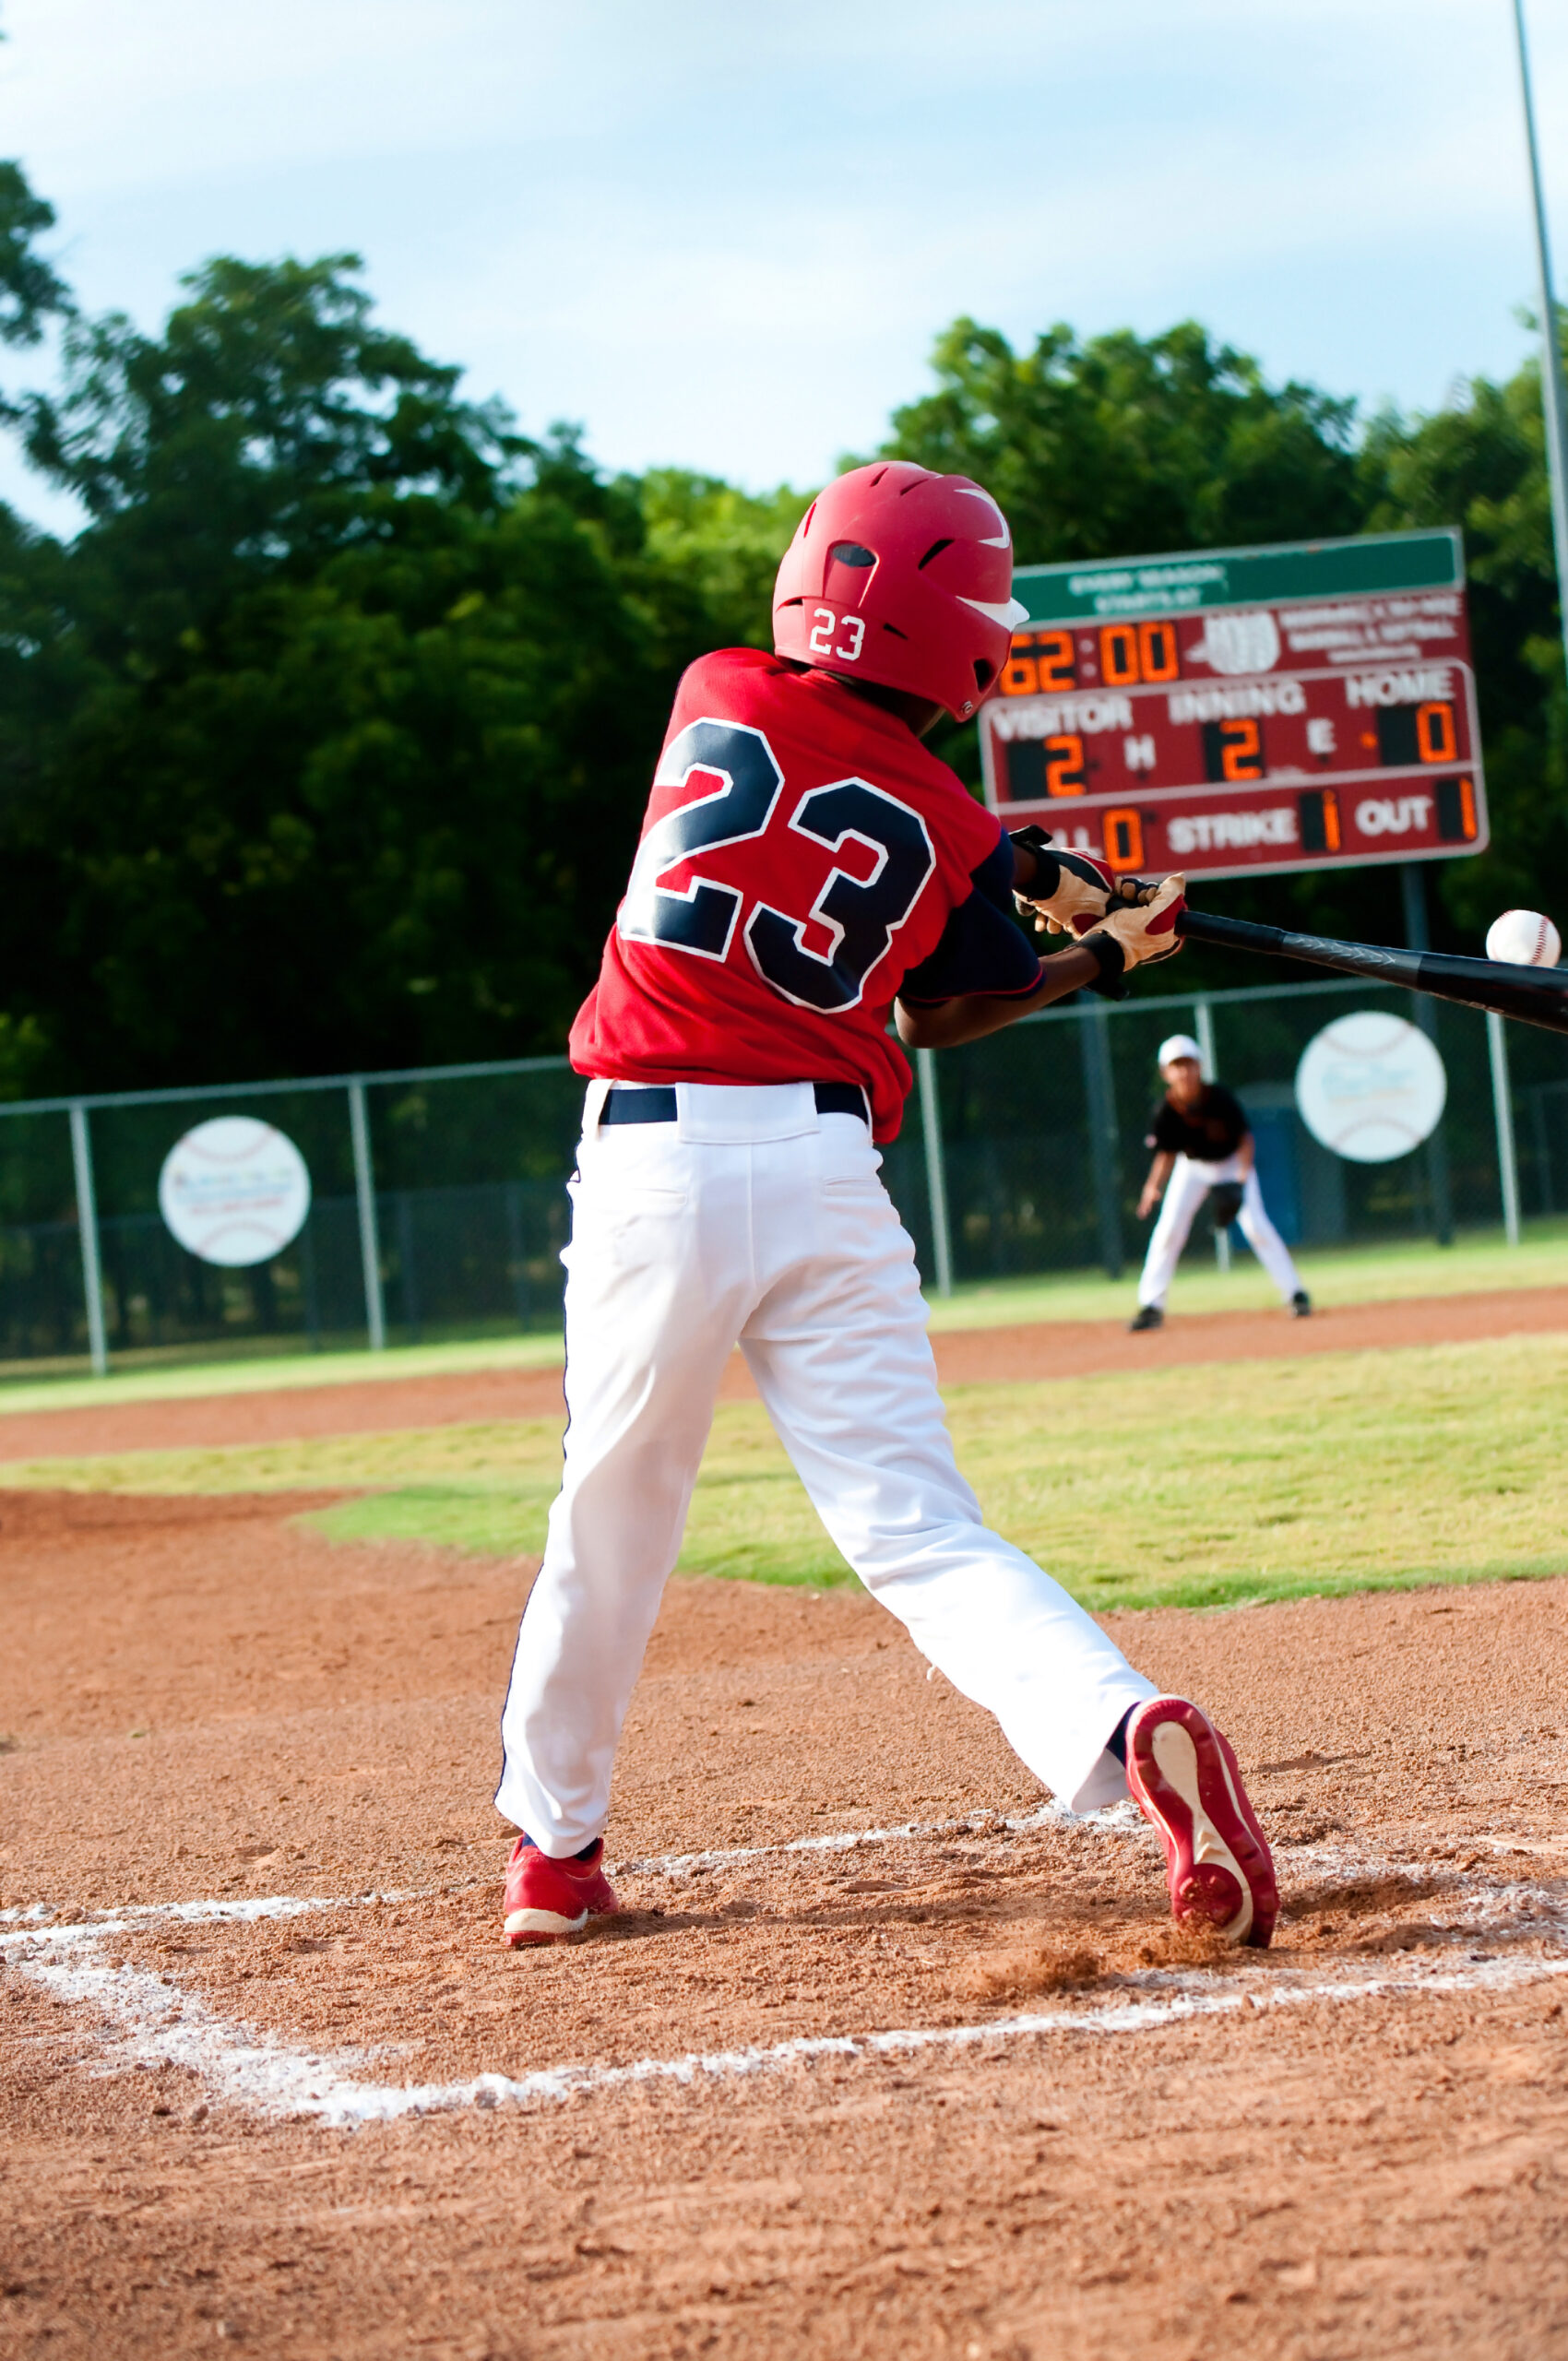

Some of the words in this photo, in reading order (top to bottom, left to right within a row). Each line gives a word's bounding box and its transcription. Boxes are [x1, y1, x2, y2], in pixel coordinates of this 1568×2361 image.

[809, 607, 865, 660] 23
[1168, 680, 1307, 726] INNING
[1345, 668, 1455, 709] HOME
[992, 694, 1134, 742] VISITOR
[1306, 718, 1337, 754] E
[1416, 700, 1458, 764] 0
[1043, 734, 1086, 799] 2
[1123, 734, 1156, 771] H
[1220, 717, 1263, 782] 2
[1167, 807, 1300, 854] STRIKE
[1322, 789, 1341, 852] 1
[1355, 794, 1433, 837] OUT
[1459, 777, 1477, 839] 1
[617, 716, 937, 1014] 23
[1103, 807, 1145, 872] 0
